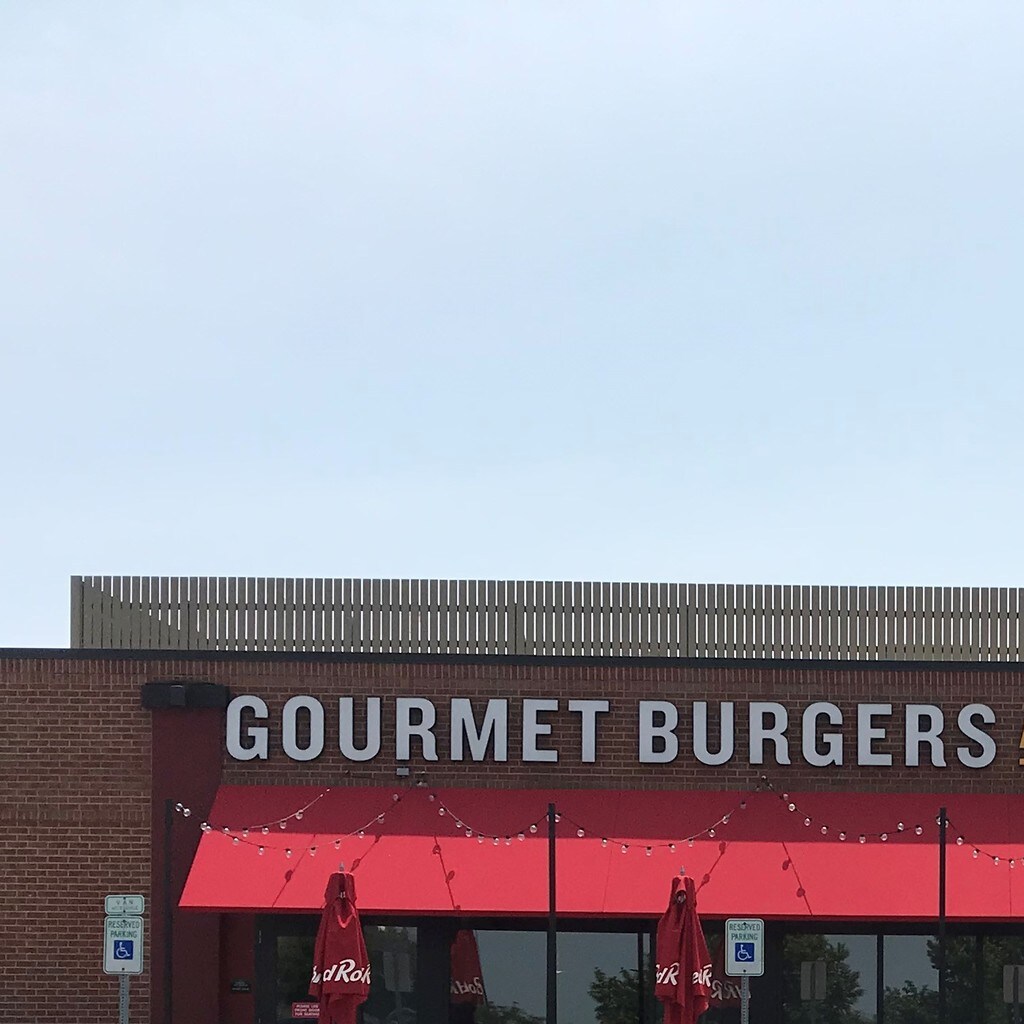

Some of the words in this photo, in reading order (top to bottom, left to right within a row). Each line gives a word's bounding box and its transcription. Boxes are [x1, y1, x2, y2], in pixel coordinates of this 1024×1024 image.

[225, 694, 610, 763] GOURMET
[638, 700, 997, 768] BURGERS
[107, 920, 140, 929] RESERVED
[728, 923, 761, 931] RESERVED
[110, 930, 138, 939] PARKING
[731, 933, 758, 941] PARKING
